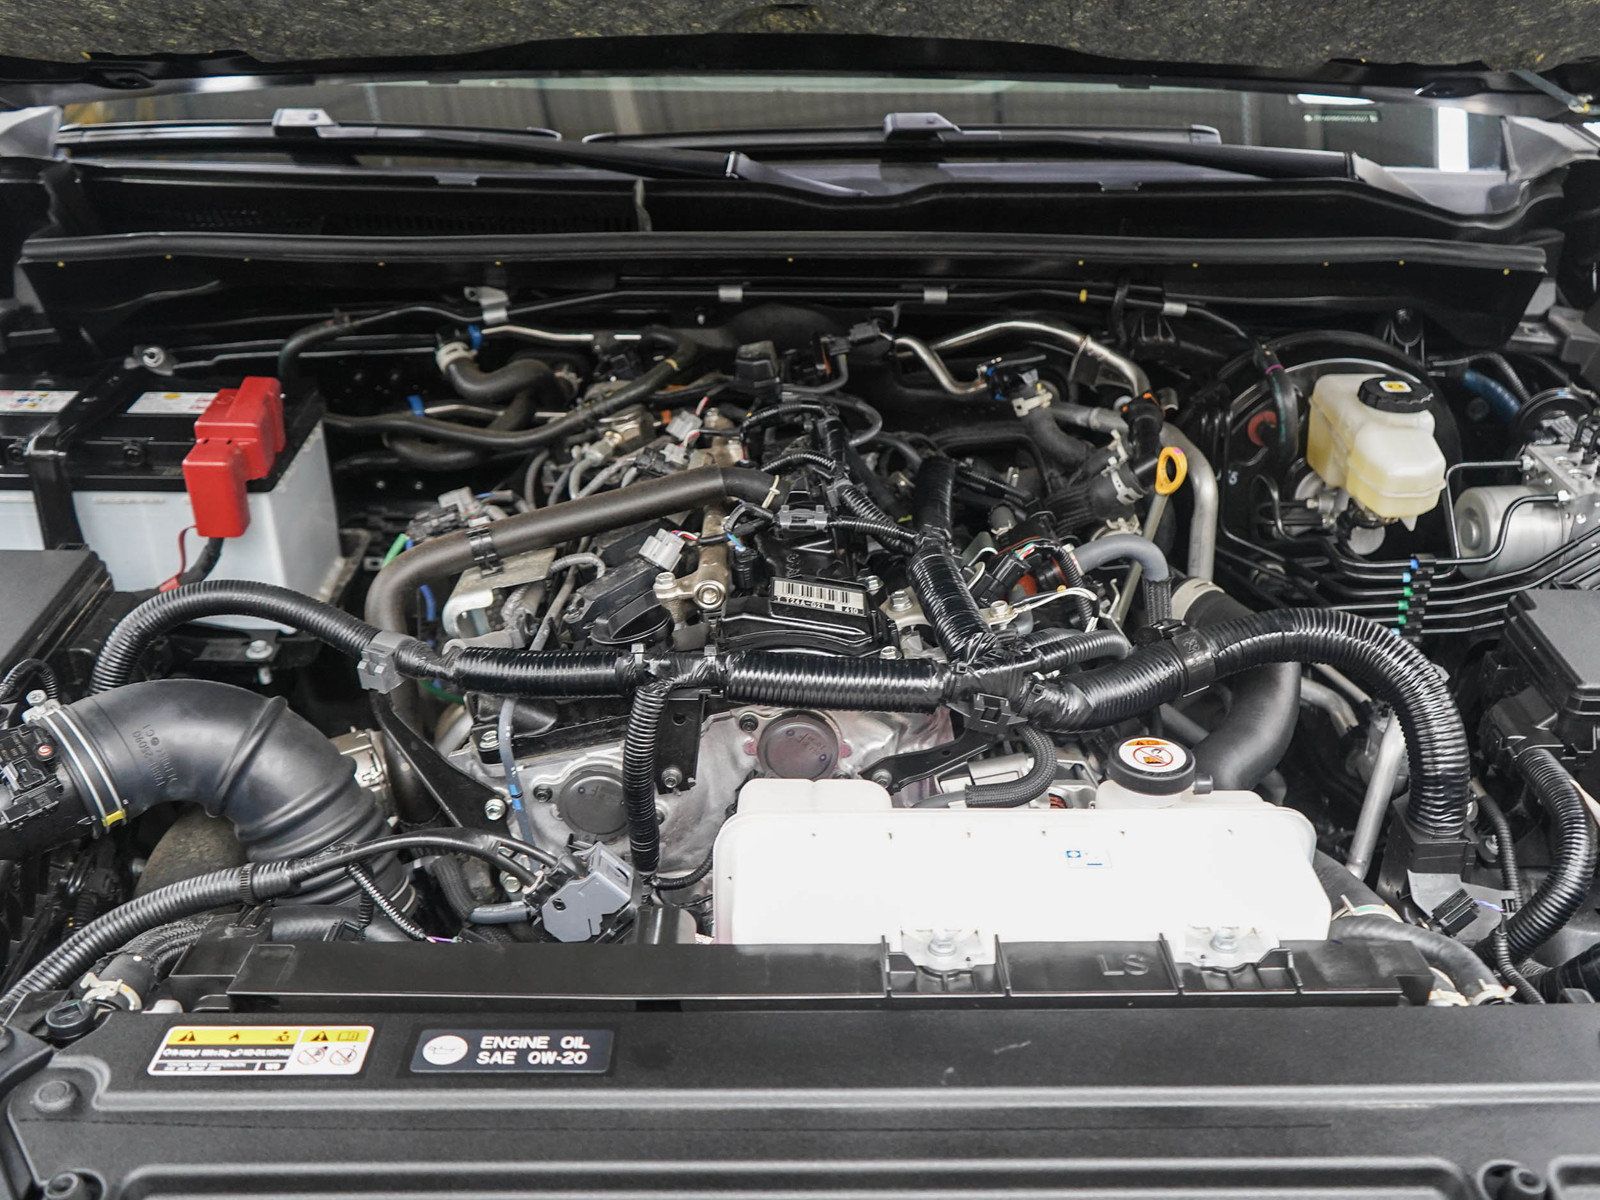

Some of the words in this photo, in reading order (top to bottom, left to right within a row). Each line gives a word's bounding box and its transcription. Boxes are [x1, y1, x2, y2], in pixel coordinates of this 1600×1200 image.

[1097, 954, 1149, 976] LS
[480, 1035, 550, 1050] ENGINE
[560, 1035, 590, 1050] OIL
[476, 1050, 517, 1065] SAE
[527, 1050, 588, 1065] 0W-20
